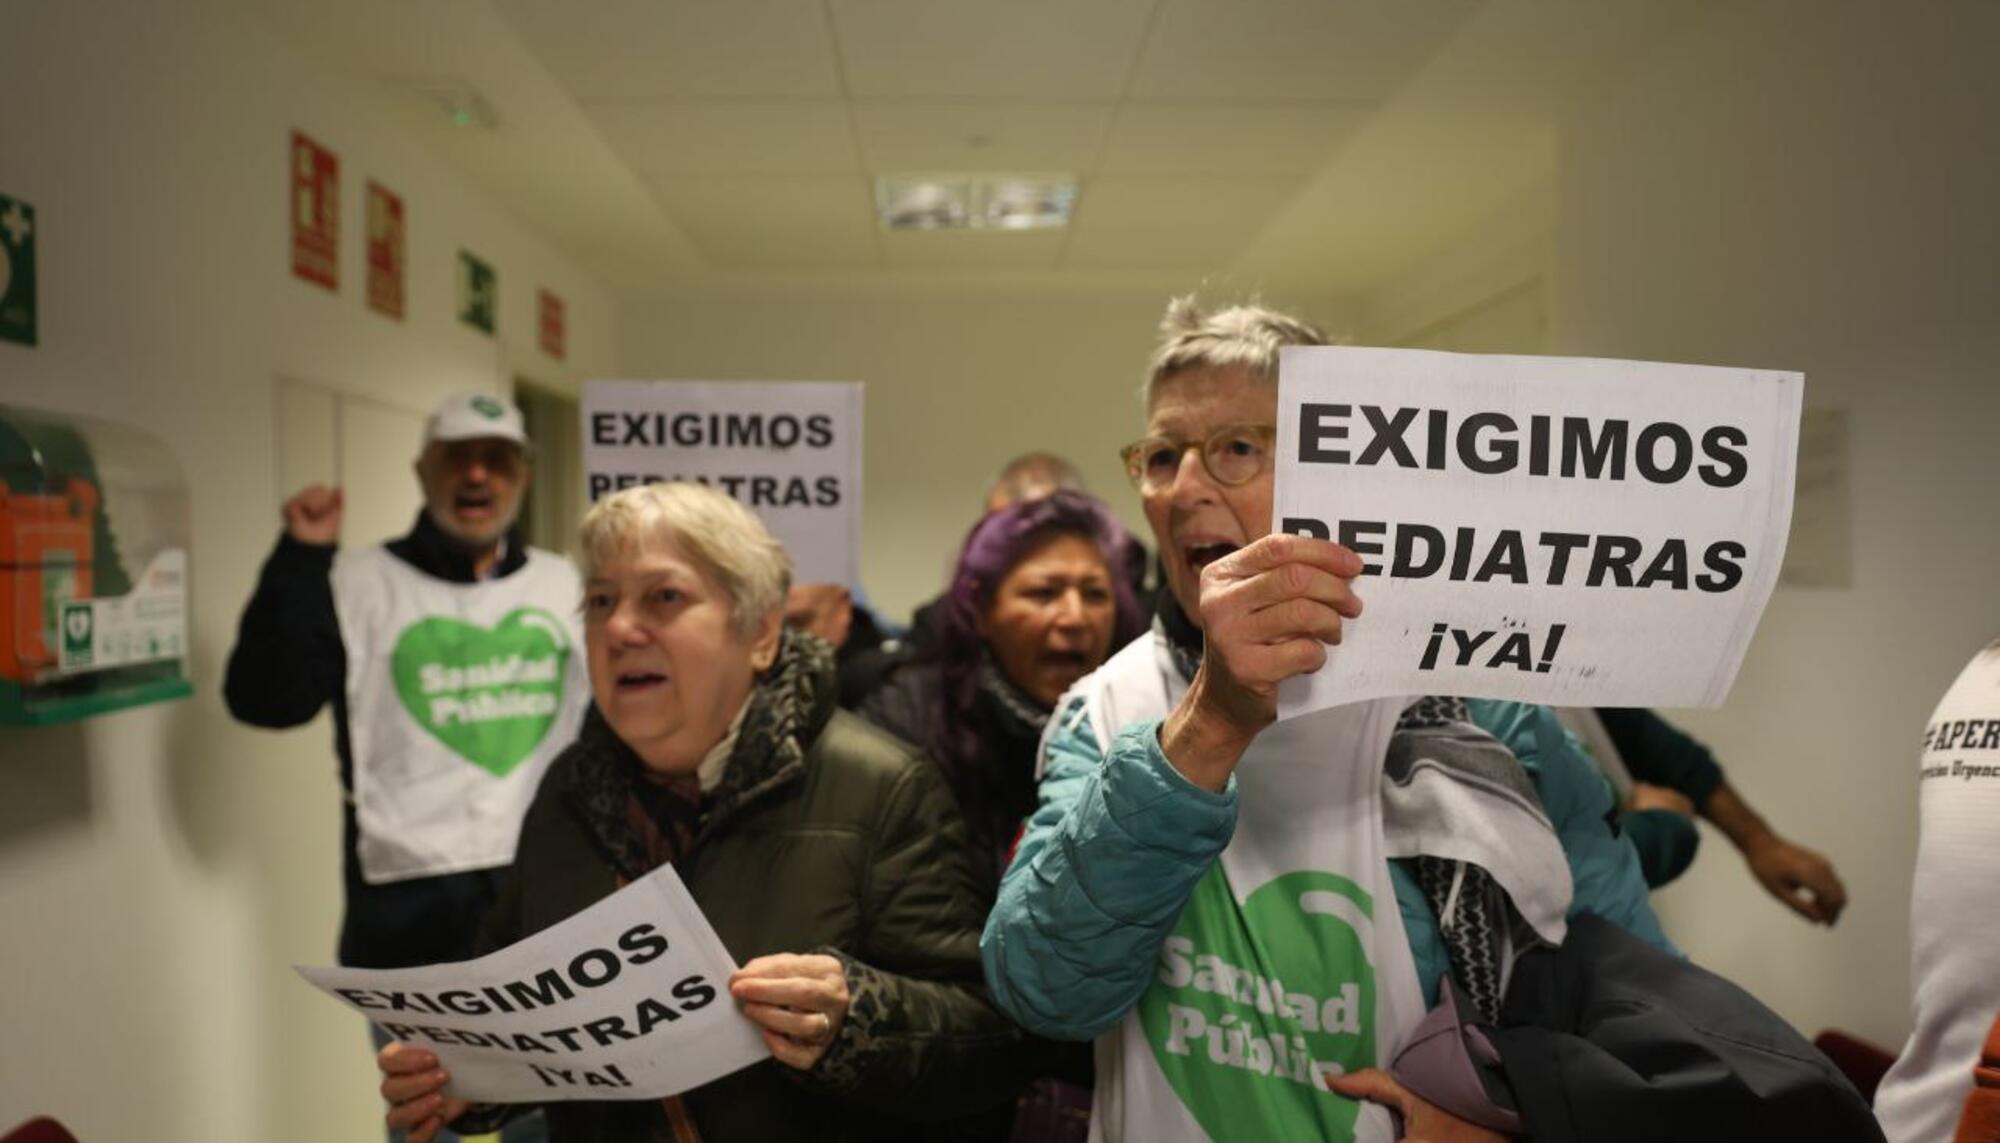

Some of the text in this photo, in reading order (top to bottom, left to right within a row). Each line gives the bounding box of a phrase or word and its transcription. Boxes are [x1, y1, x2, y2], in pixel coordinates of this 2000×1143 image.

[591, 411, 833, 449] EXIGIMOS
[1298, 402, 1749, 488] EXIGIMOS
[589, 474, 841, 507] PTRAS
[1418, 623, 1567, 673] ¡YA!
[333, 922, 669, 1015] EXIGIMOS
[381, 974, 718, 1053] PEDIATRAS
[527, 1063, 633, 1088] ¡YA!
